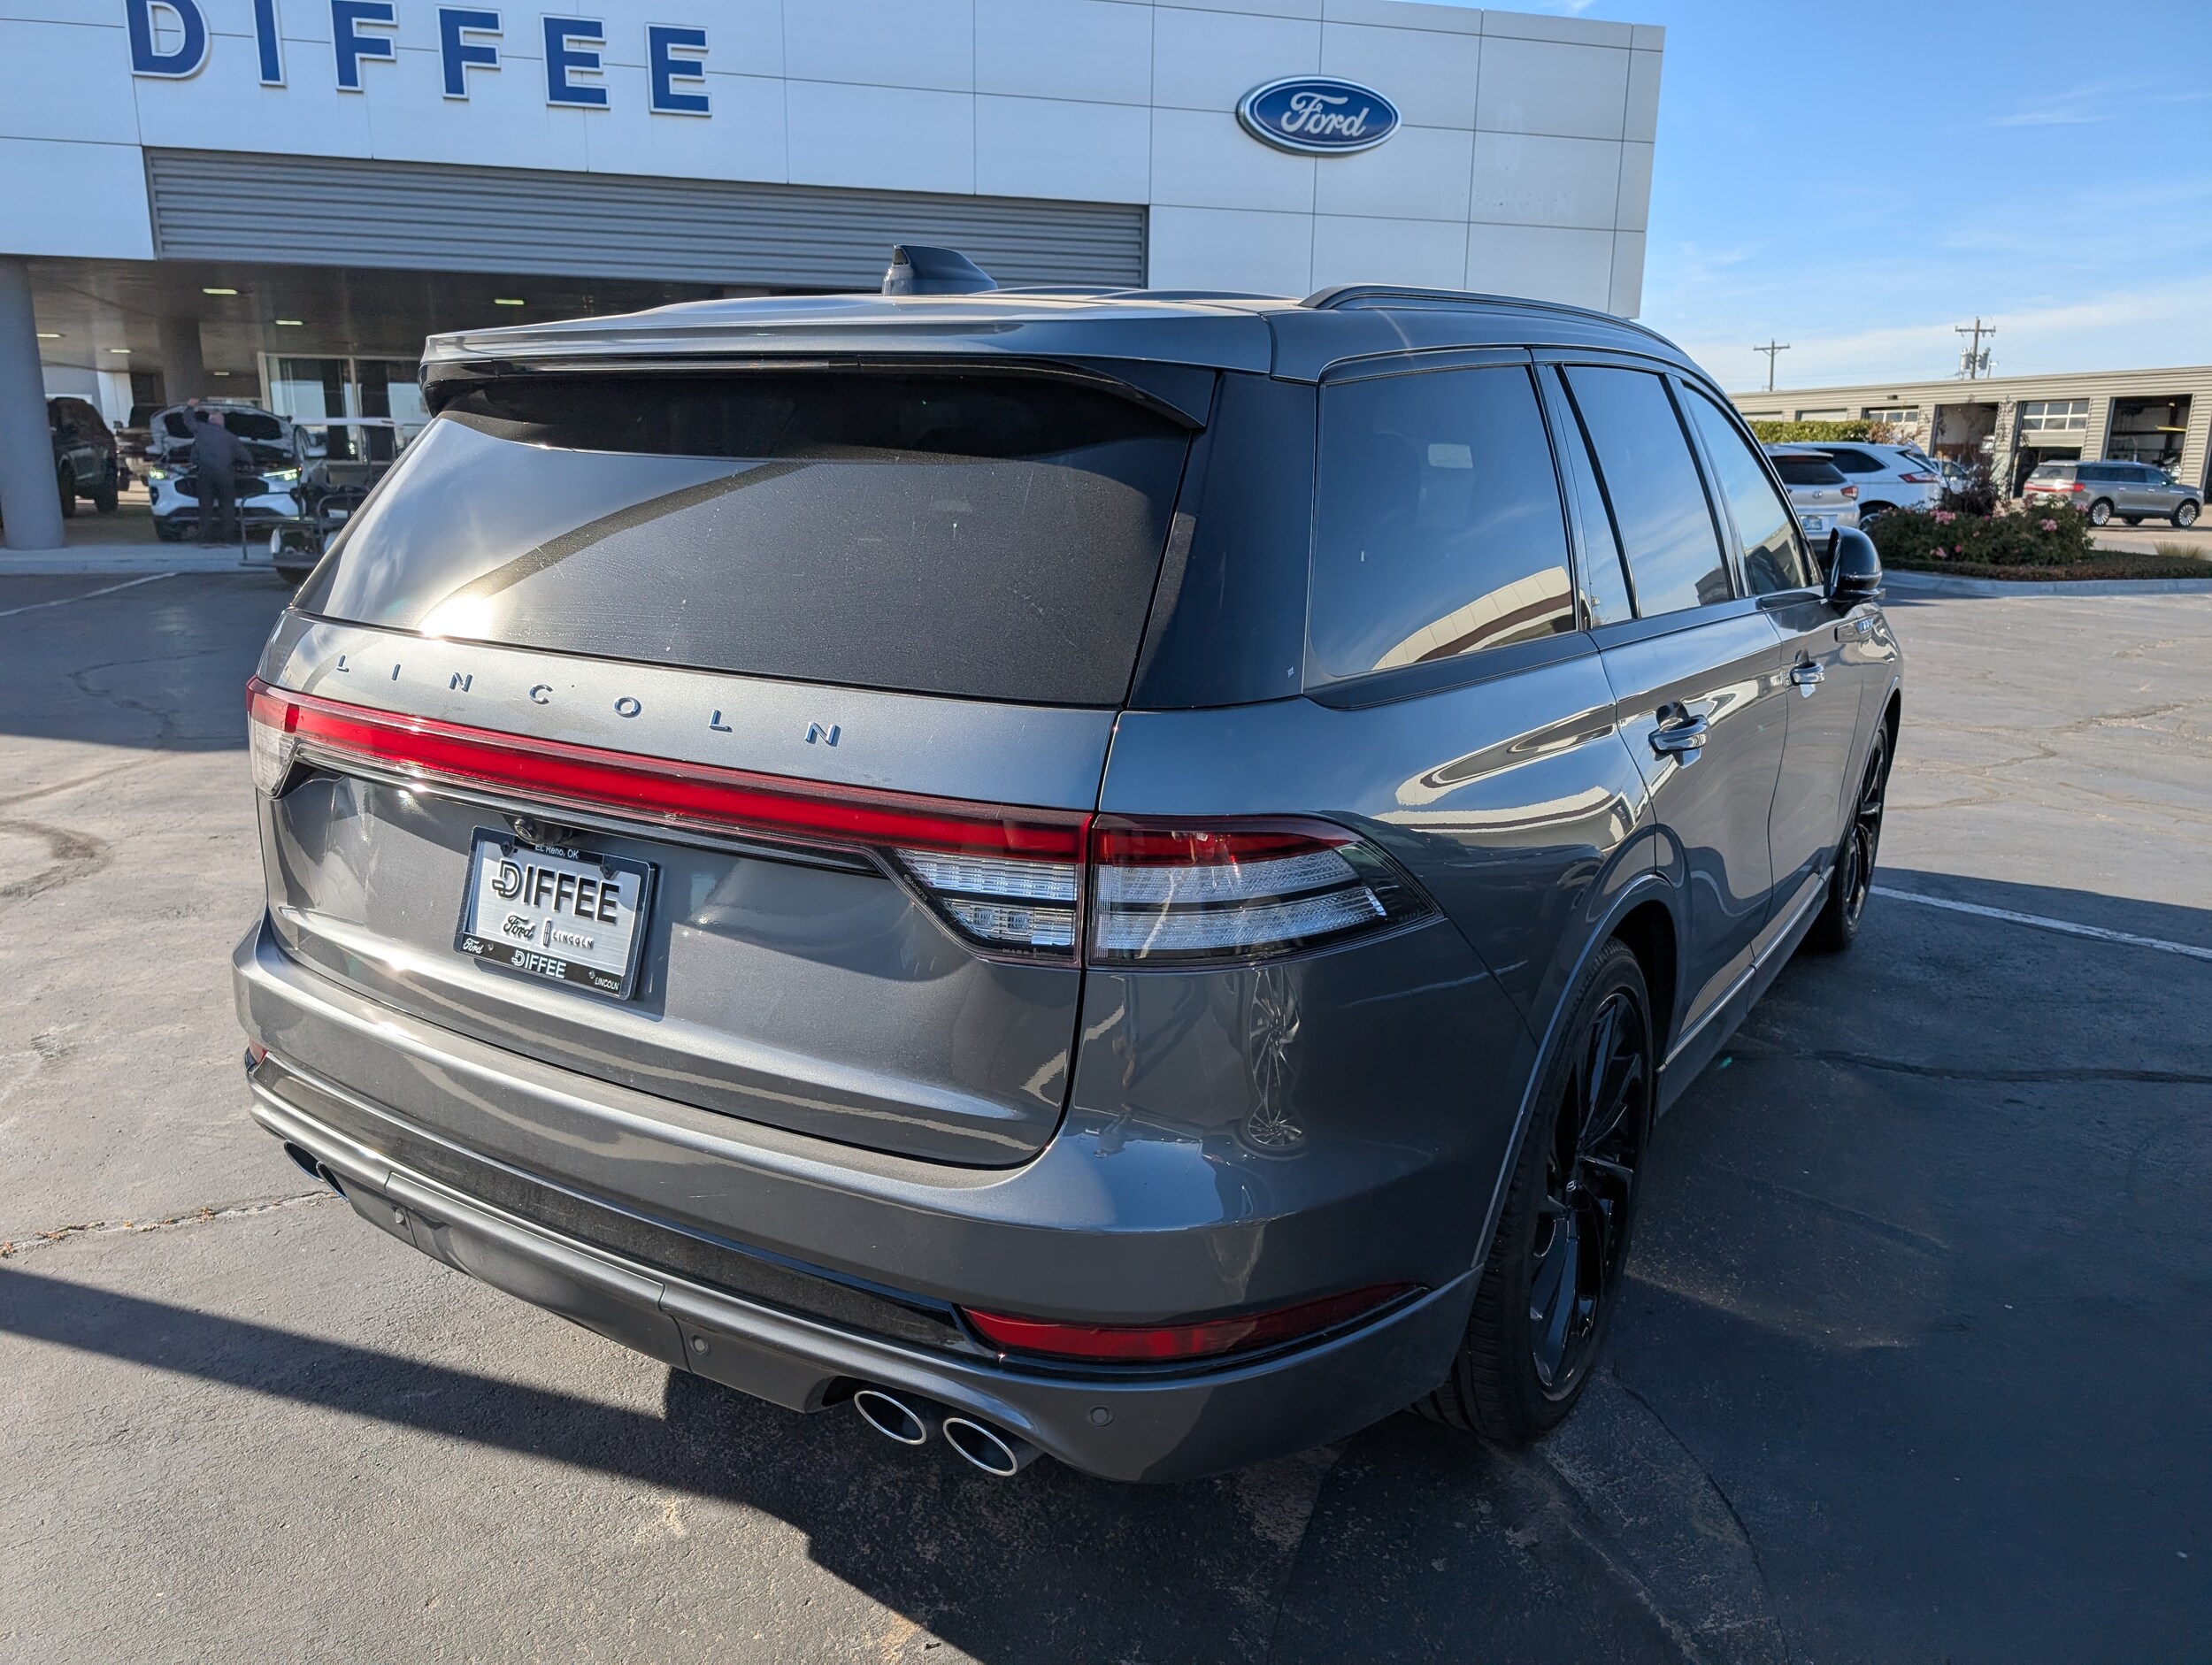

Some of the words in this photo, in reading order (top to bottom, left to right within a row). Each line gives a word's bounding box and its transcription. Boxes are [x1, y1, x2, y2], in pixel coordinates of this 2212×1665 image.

[125, 0, 711, 116] DIFFEE
[1280, 91, 1370, 137] Ford
[336, 655, 842, 748] LINCOLN
[567, 849, 580, 859] OK
[491, 859, 620, 925] DIFFEE
[503, 915, 534, 940] Ford
[552, 930, 595, 949] LINCOLN
[463, 938, 484, 955] Ford
[511, 949, 567, 979] DIFFEE
[595, 977, 620, 990] LINCOLN
